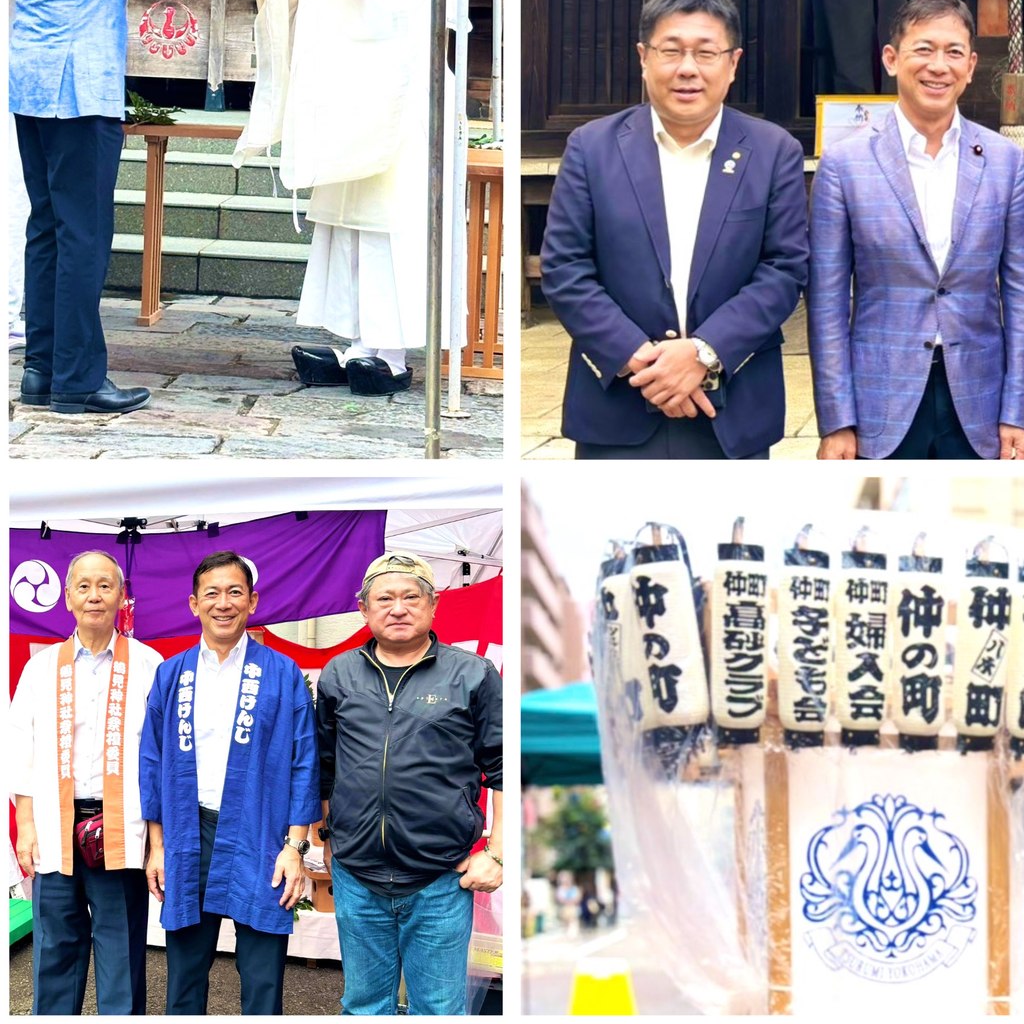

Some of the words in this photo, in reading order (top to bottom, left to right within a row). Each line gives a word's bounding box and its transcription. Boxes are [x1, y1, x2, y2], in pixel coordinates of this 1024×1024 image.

[234, 663, 262, 744] 中西けんじ
[723, 601, 766, 718] 高砂クラブ
[897, 585, 944, 724] 仲の町
[178, 670, 194, 751] 中西けんじ
